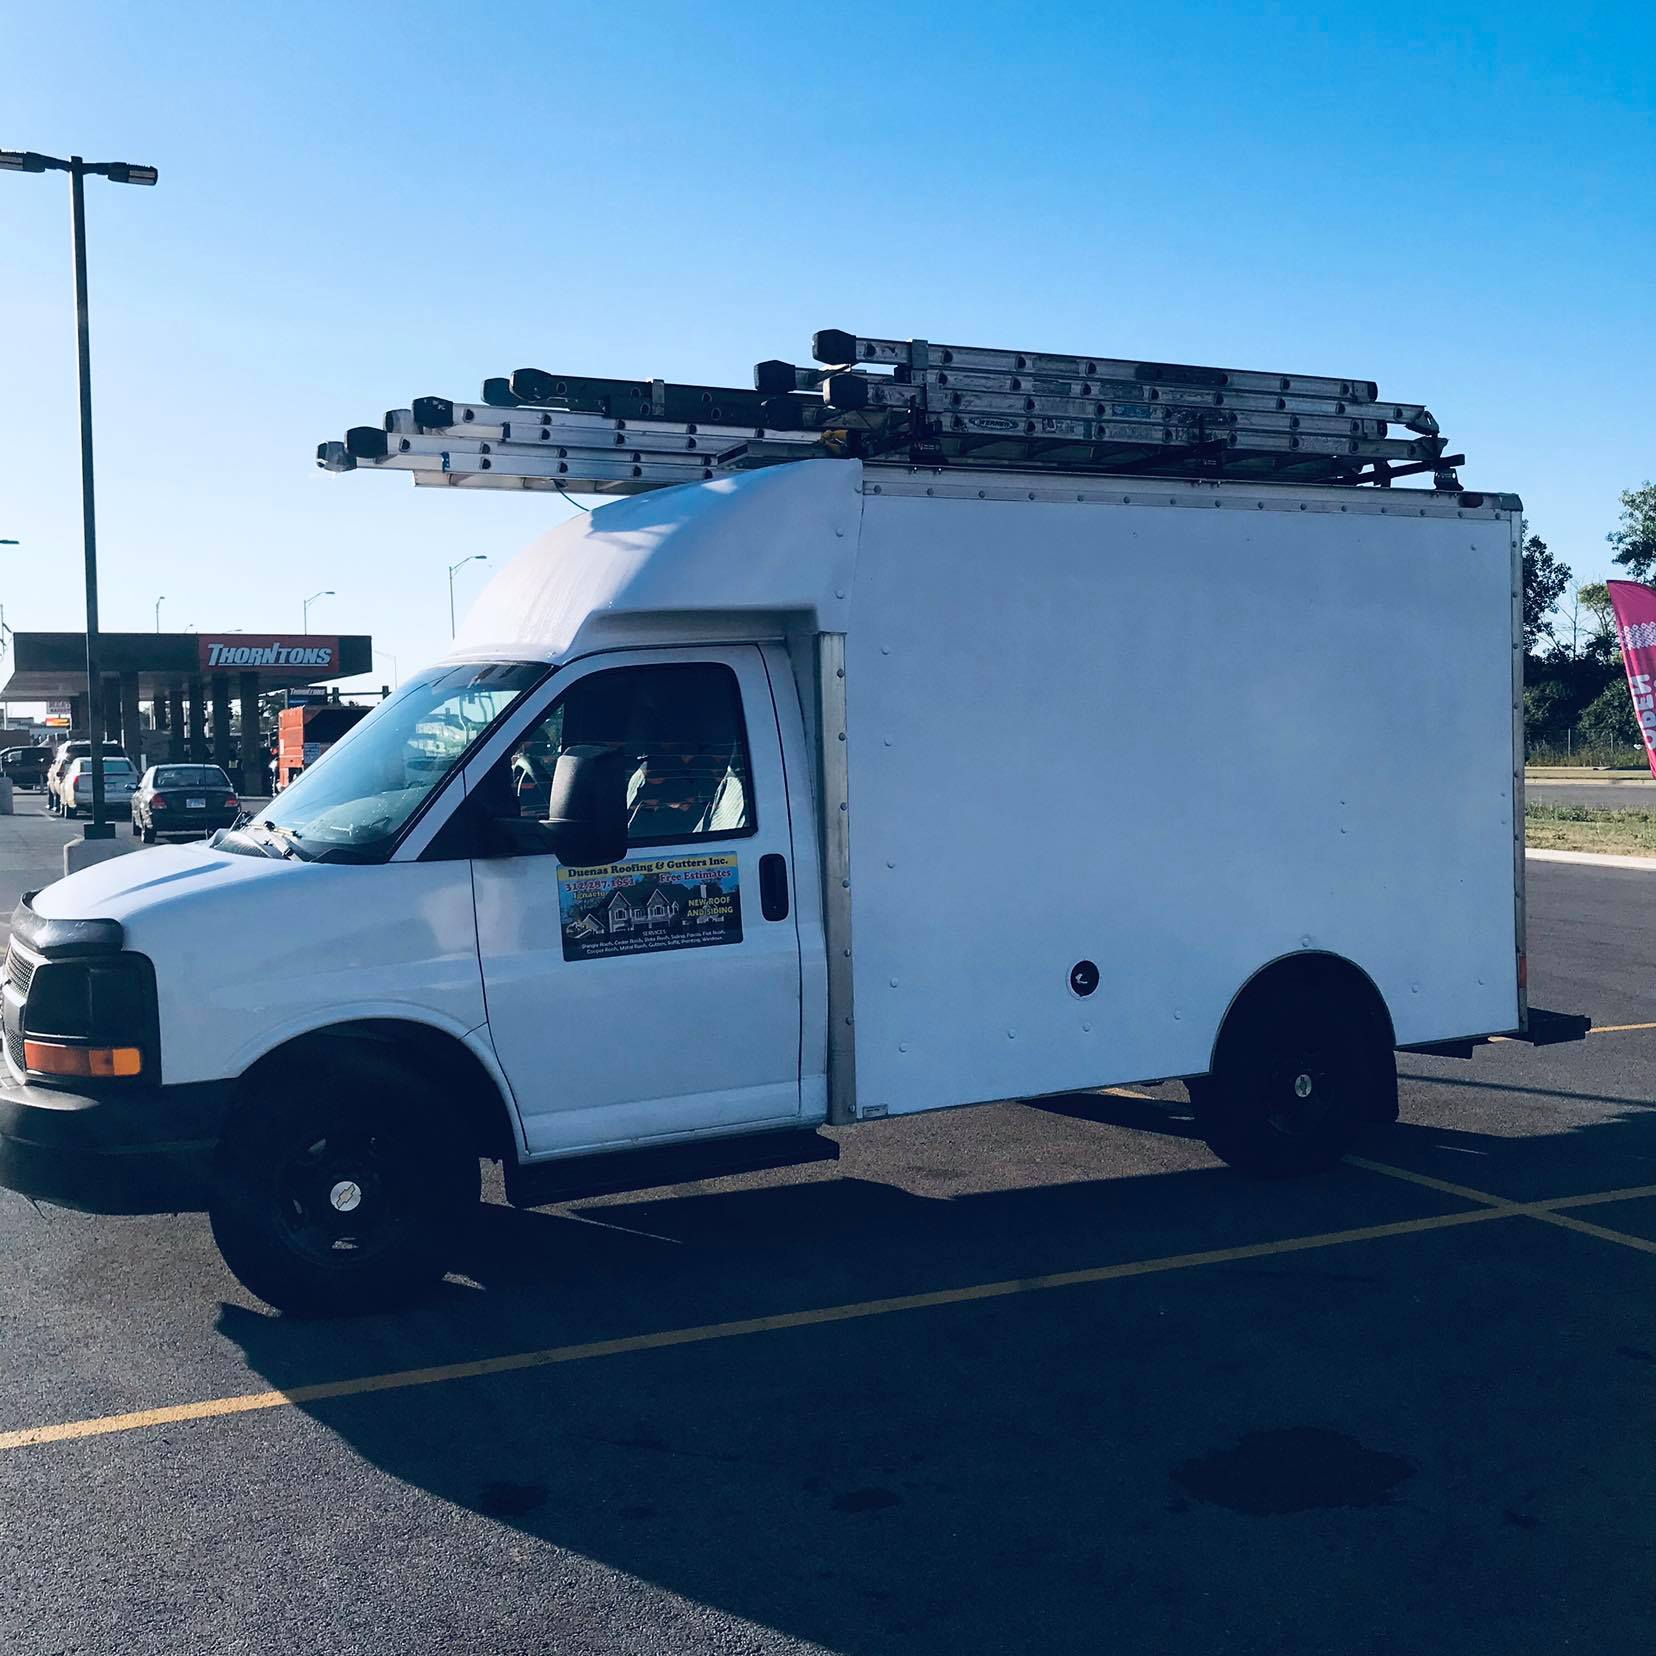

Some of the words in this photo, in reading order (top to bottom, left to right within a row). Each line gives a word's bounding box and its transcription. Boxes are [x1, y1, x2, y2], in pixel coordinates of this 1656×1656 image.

[208, 643, 332, 666] THORNTONS
[568, 867, 609, 877] Duenas
[611, 863, 653, 874] Roofing
[655, 861, 664, 870] &
[667, 859, 706, 869] Gutters
[709, 857, 728, 865] Inc.
[659, 873, 682, 882] Free
[684, 870, 732, 880] Estimates
[688, 899, 706, 907] NEW
[708, 897, 731, 905] ROOF
[687, 909, 705, 917] AND
[706, 906, 733, 916] SIDING
